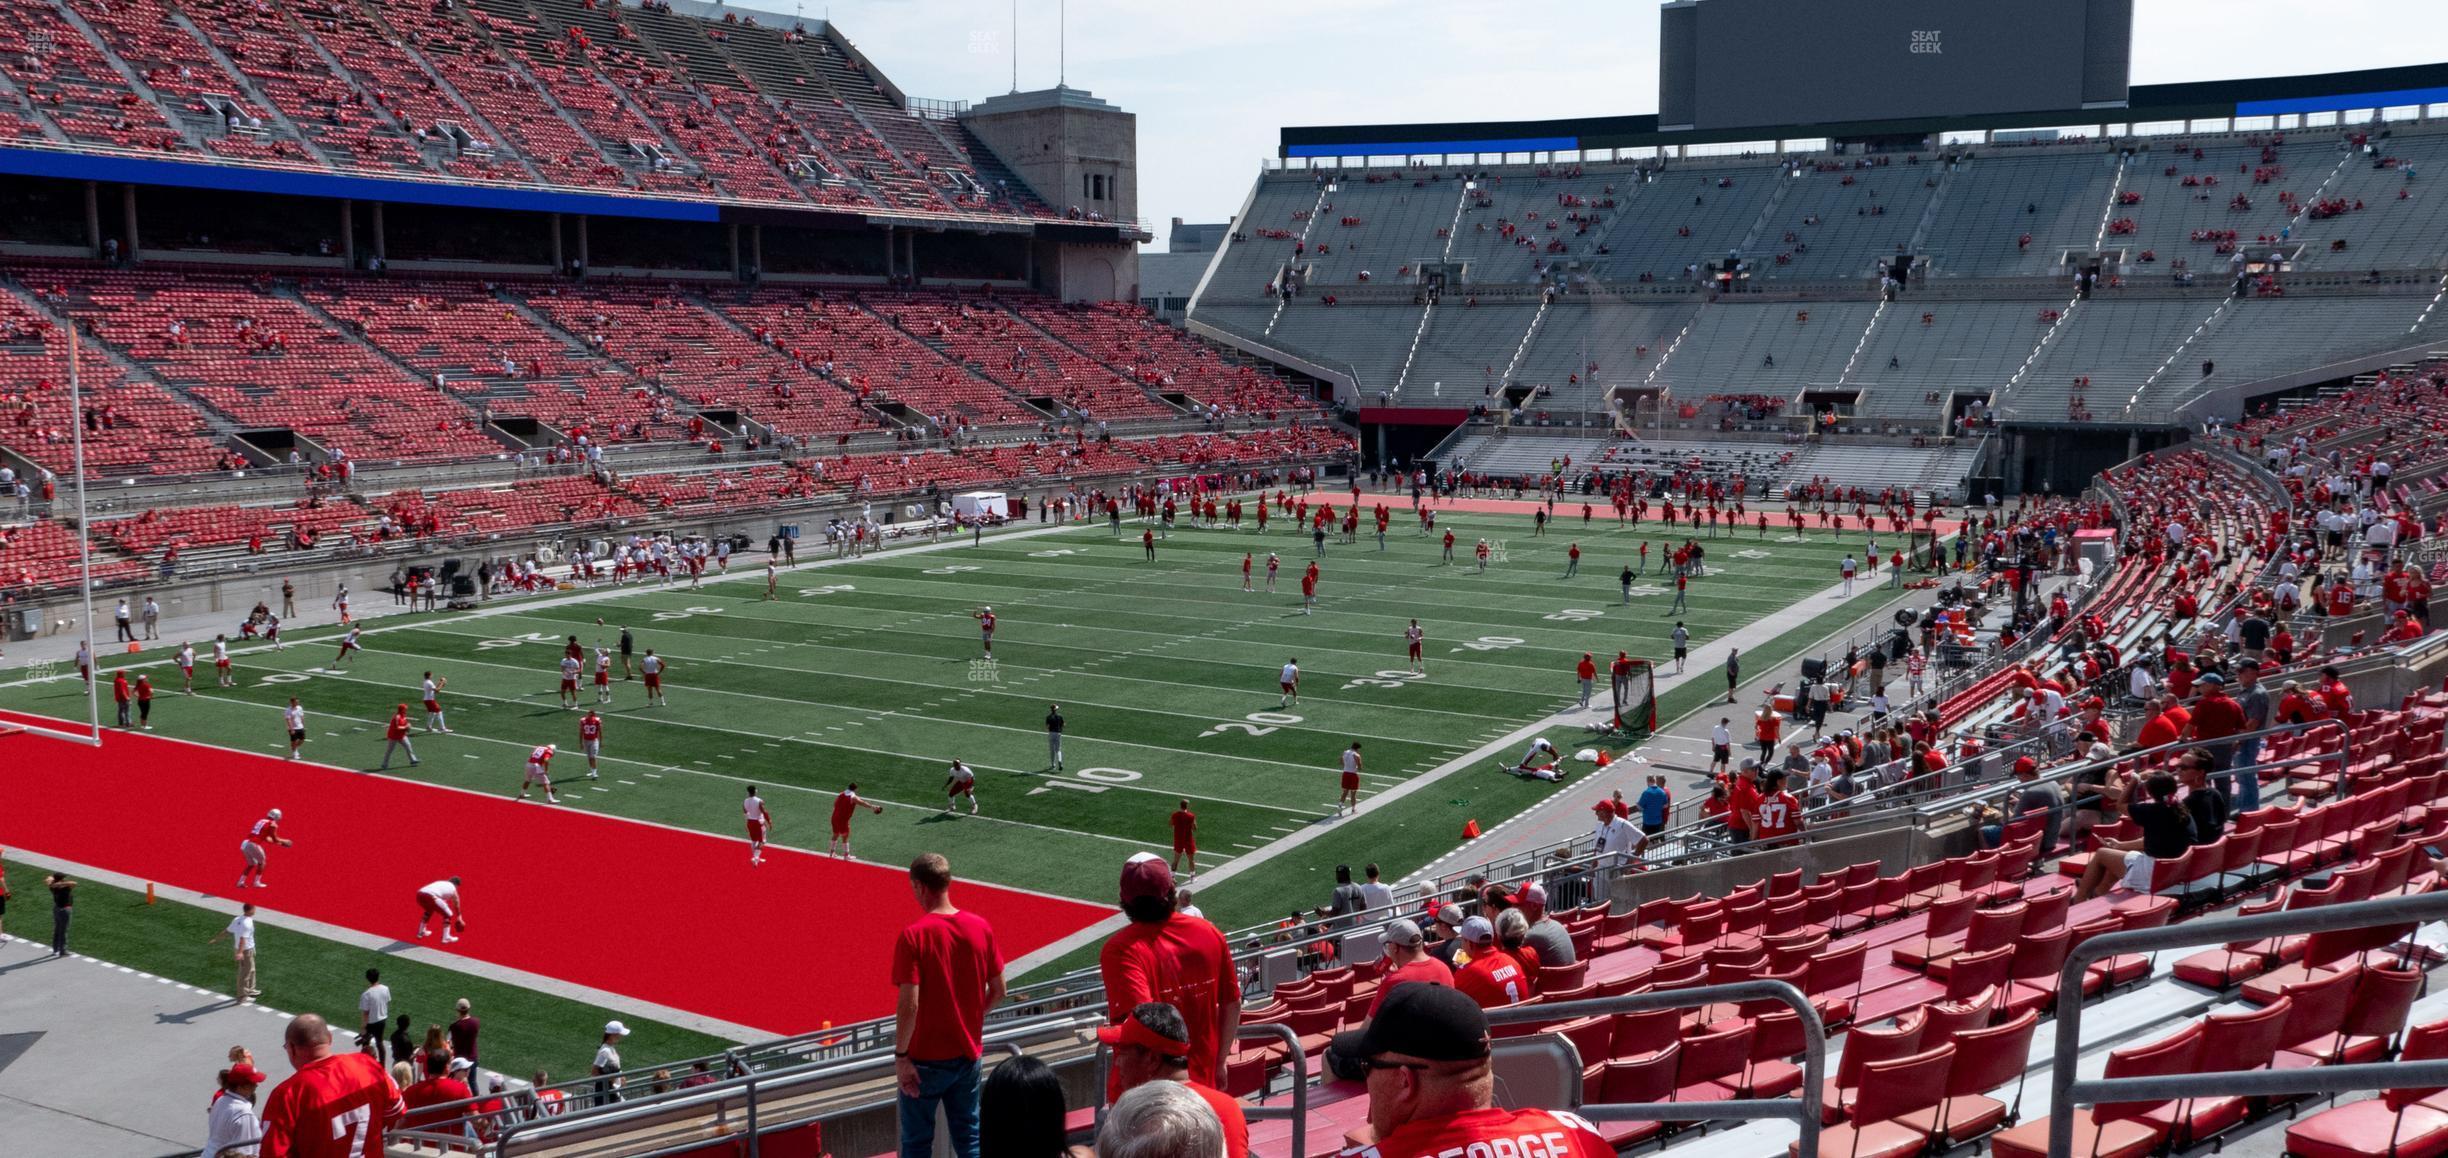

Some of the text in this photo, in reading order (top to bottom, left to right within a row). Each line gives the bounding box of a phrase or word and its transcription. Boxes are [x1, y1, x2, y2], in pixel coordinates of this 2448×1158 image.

[1542, 608, 1605, 622] 50
[1463, 636, 1526, 651] 40
[1351, 670, 1427, 688] 30
[1214, 712, 1304, 736] 20
[1045, 767, 1143, 793] 10
[1759, 804, 1787, 829] 97
[1492, 964, 1518, 983] DIXON
[1505, 980, 1519, 1005] 1
[331, 1102, 371, 1158] 7
